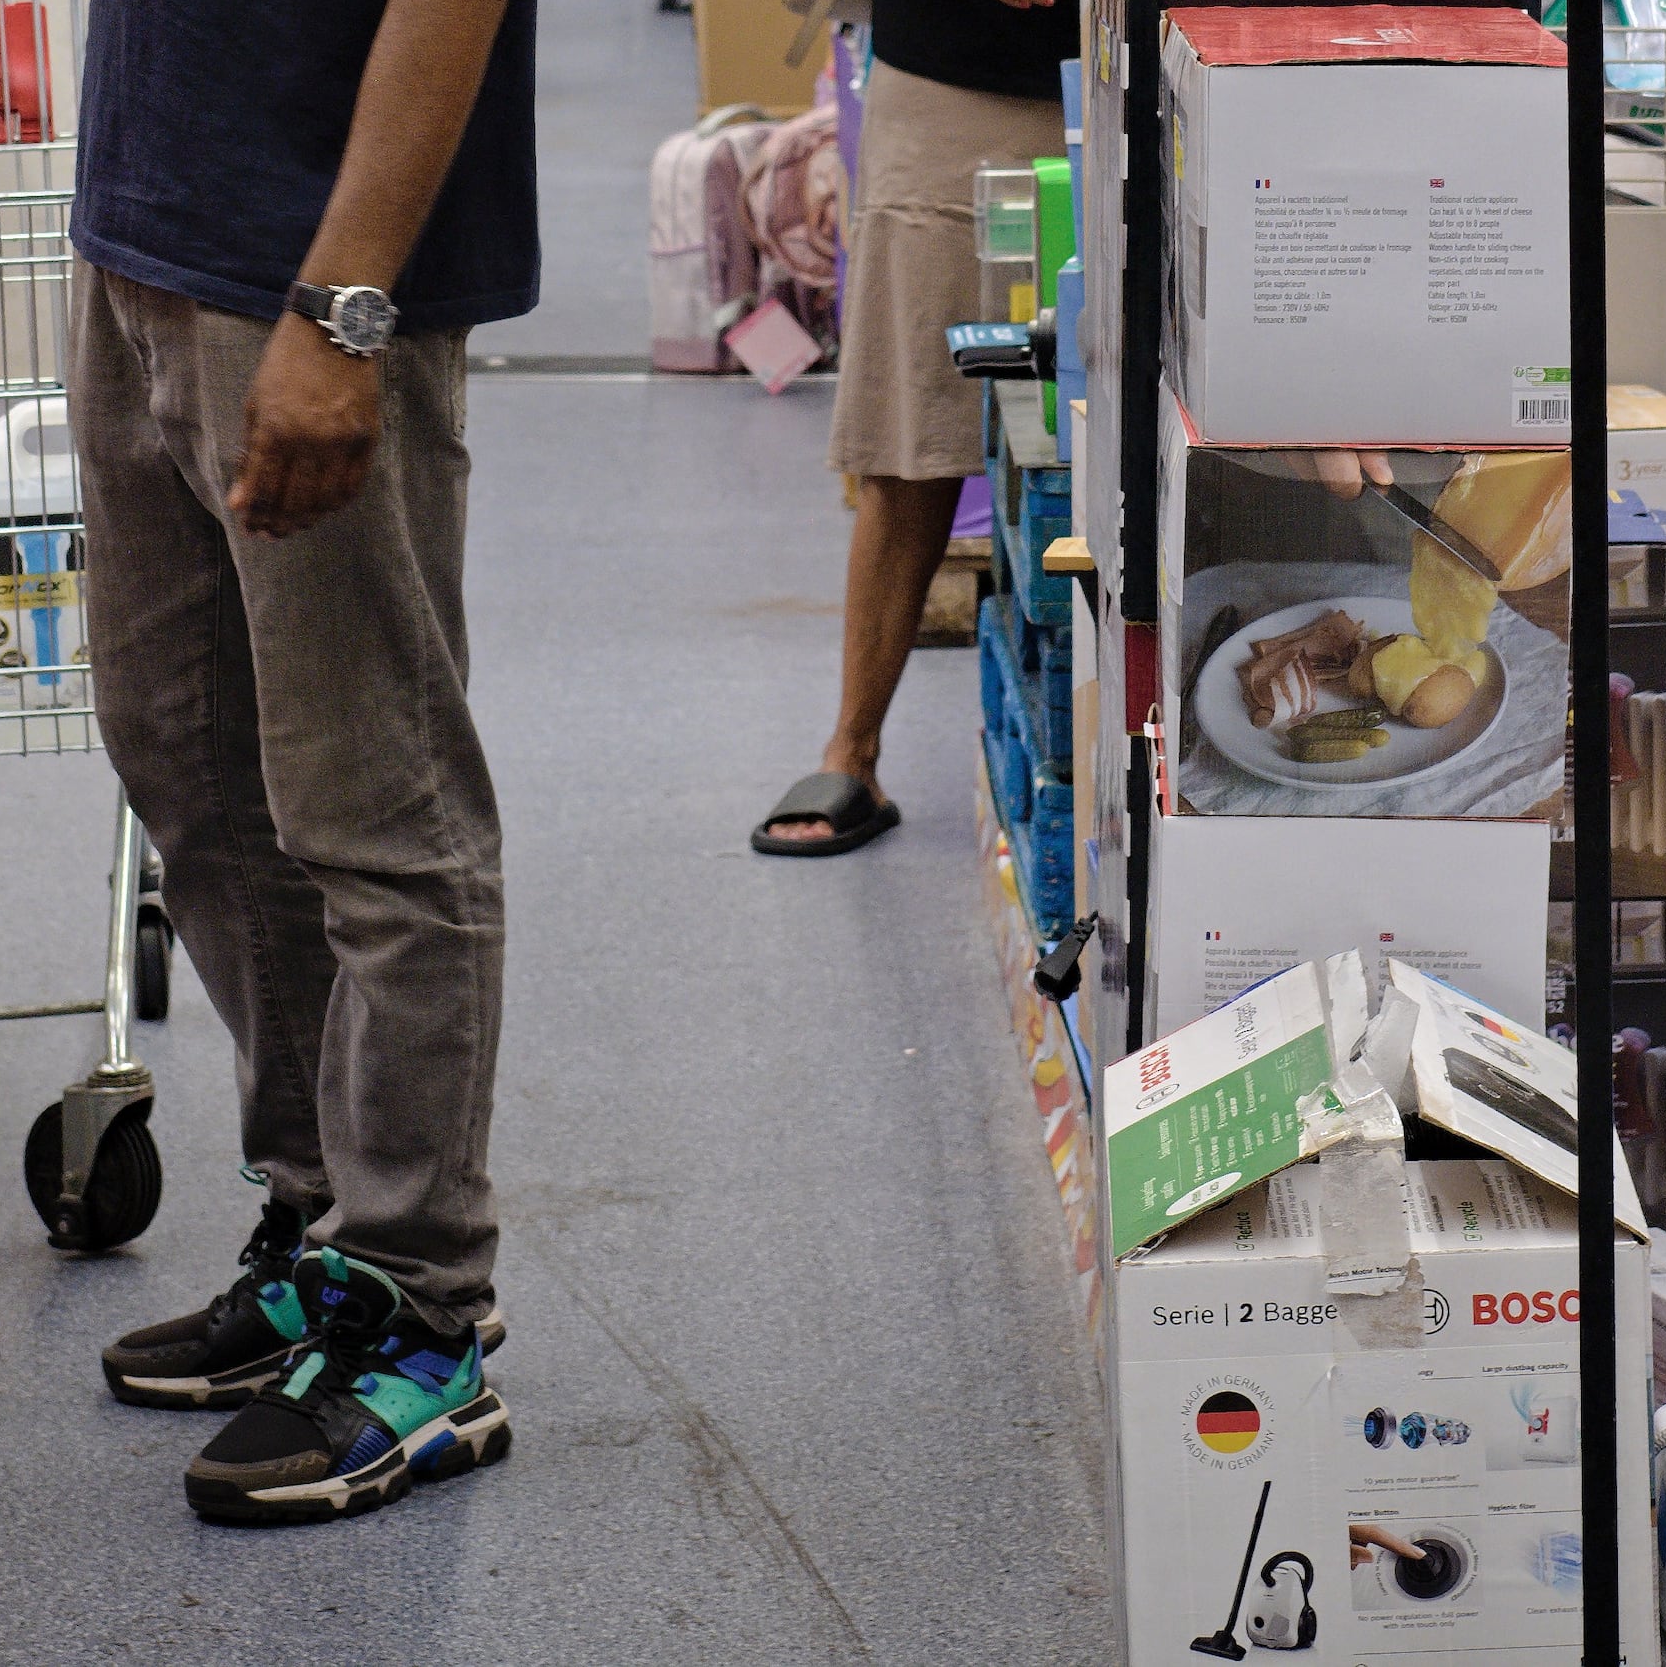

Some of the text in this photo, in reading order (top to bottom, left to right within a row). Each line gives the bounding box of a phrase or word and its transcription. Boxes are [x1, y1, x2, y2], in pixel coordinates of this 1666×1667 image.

[1139, 1044, 1172, 1093] BOSCH
[1236, 1211, 1250, 1241] Reduce
[1457, 1200, 1480, 1231] Recycle
[1152, 1301, 1338, 1326] Serie 2 Bagge
[1181, 1374, 1275, 1417] MADE IN GERMANY
[1181, 1430, 1276, 1471] MADE IN GERMANY
